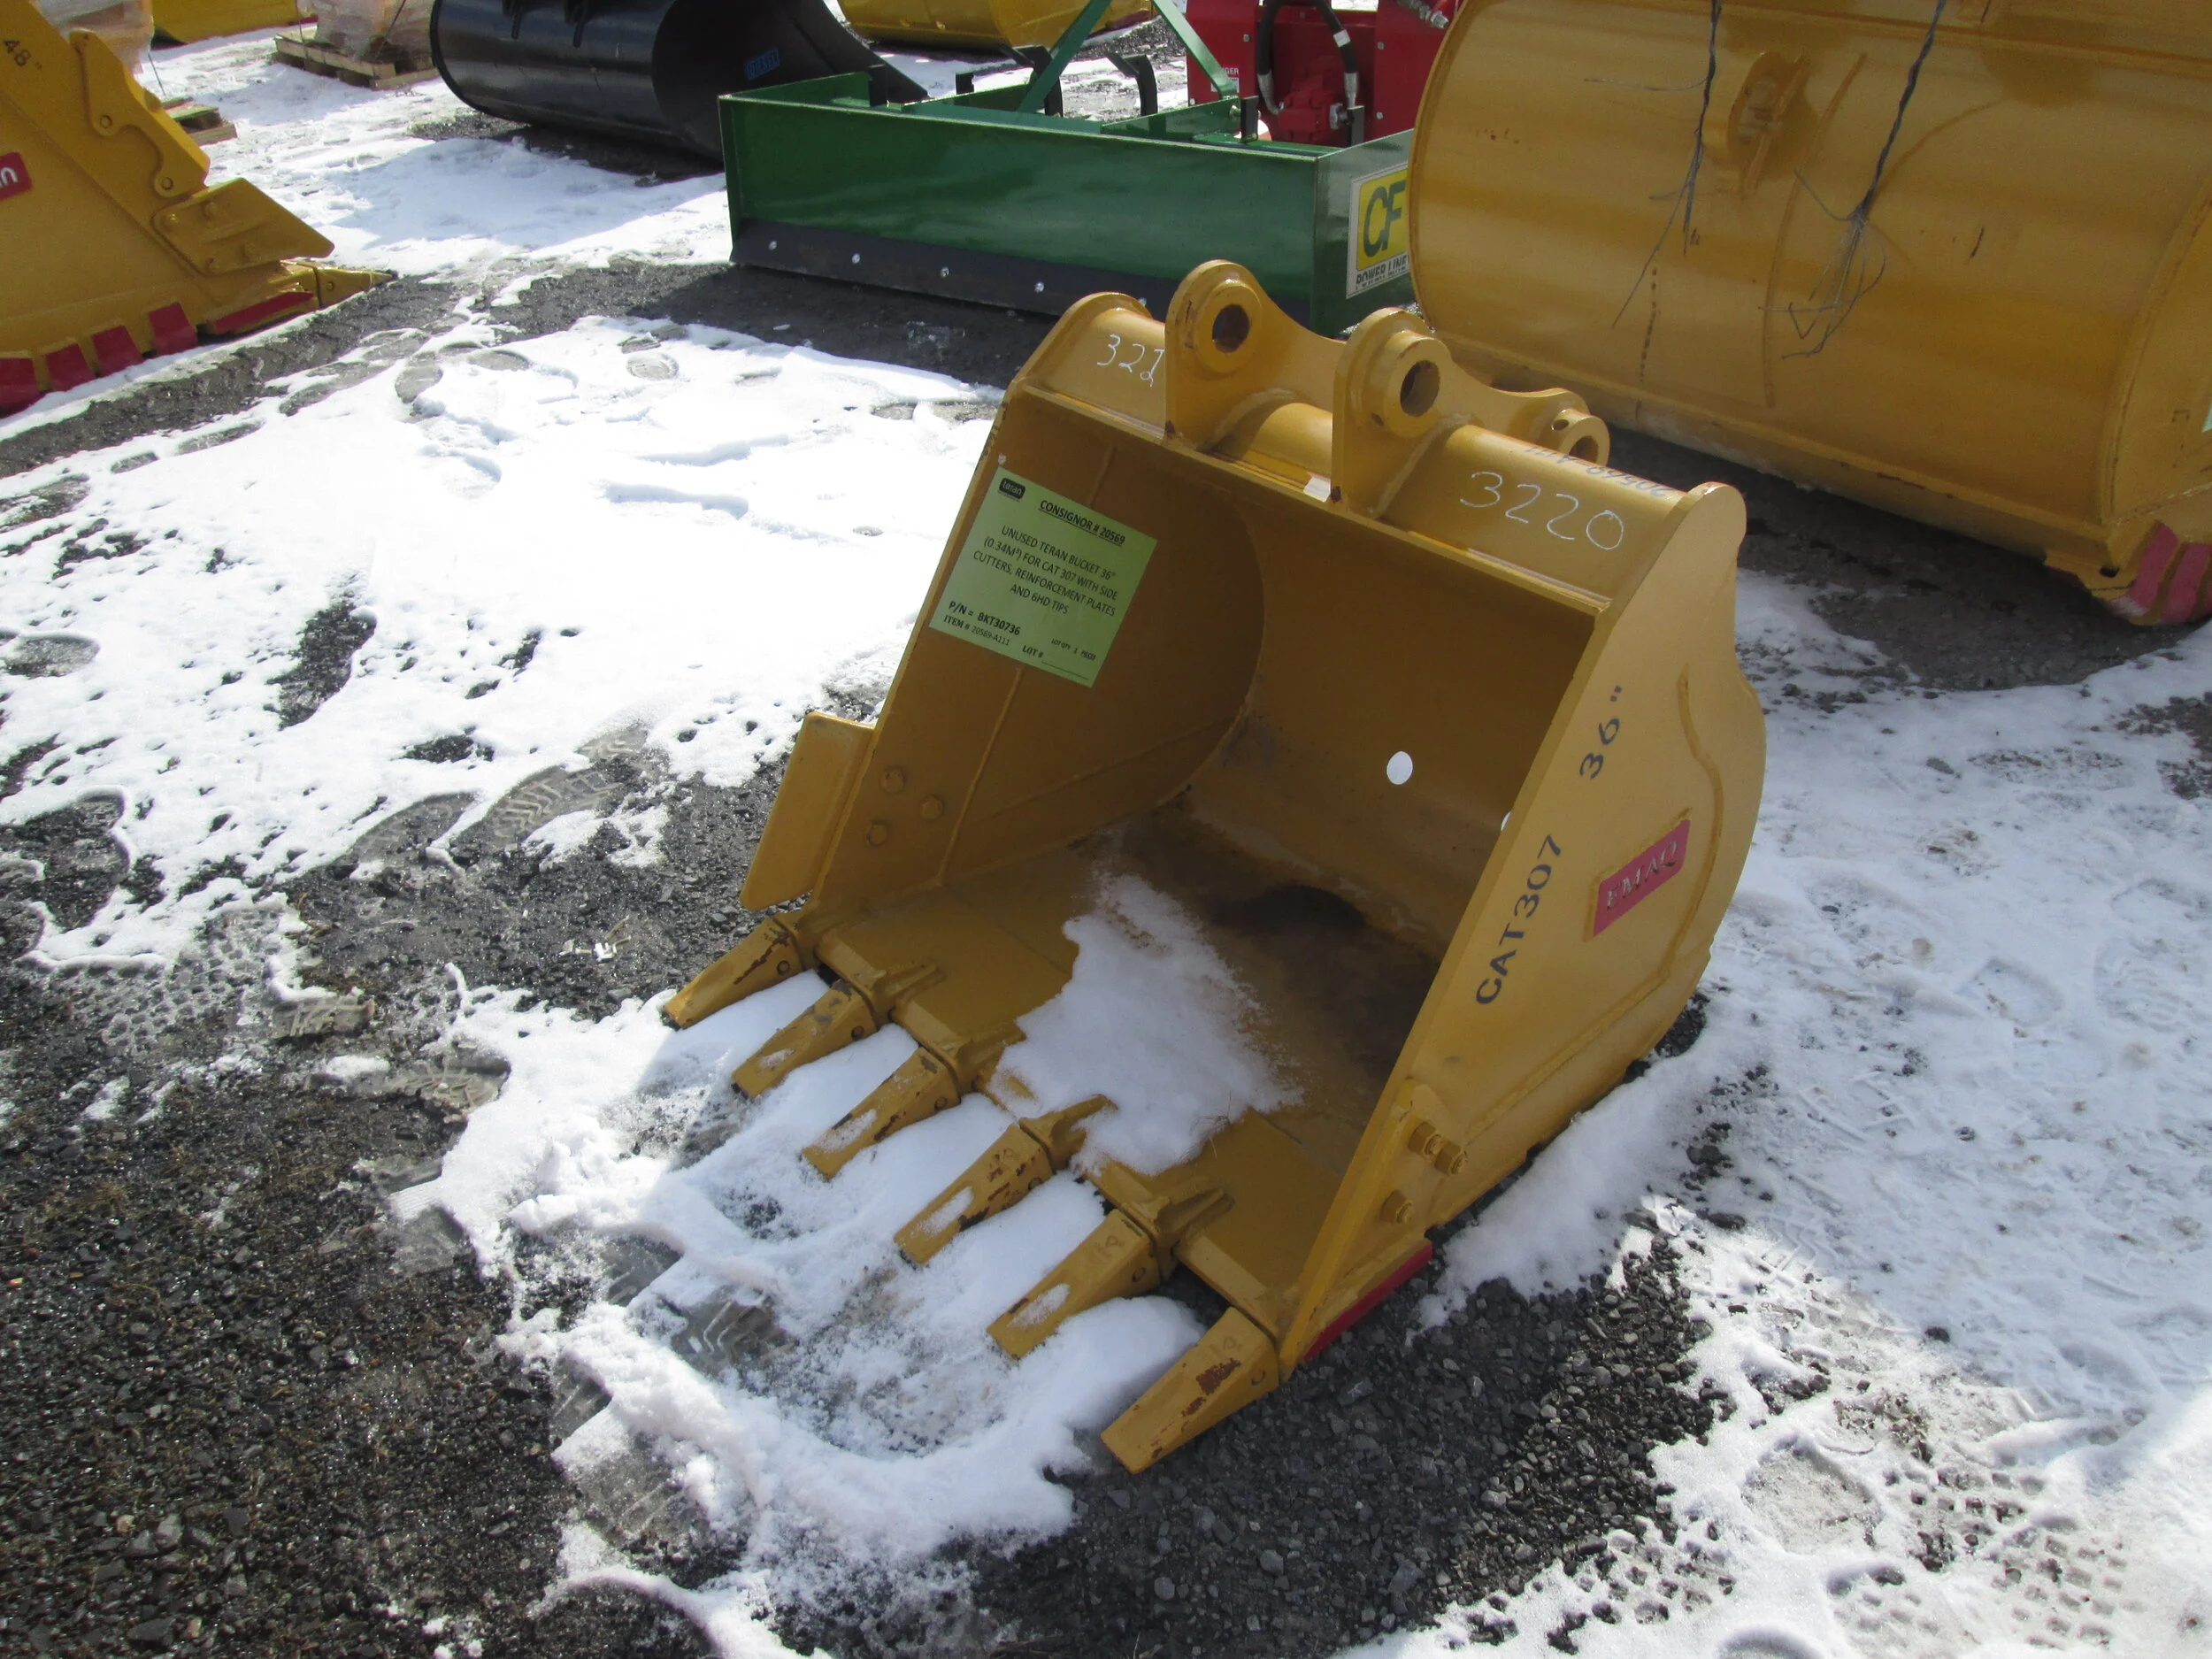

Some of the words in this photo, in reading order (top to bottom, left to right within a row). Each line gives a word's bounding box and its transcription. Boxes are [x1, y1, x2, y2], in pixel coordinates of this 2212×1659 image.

[1002, 480, 1023, 495] teran
[1040, 500, 1093, 531] CONSIGNOR
[1100, 527, 1125, 545] 20569
[1460, 471, 1624, 550] 3220
[1002, 525, 1038, 547] UNUSED
[1040, 541, 1068, 561] TERAN
[1069, 555, 1101, 573] BUCKET
[973, 550, 1012, 574] CUTTERS,
[1015, 567, 1087, 603] REINFORCEMENT
[1087, 597, 1116, 617] PLATES
[1023, 553, 1041, 567] FOR
[1041, 561, 1060, 574] CAT
[1060, 569, 1077, 581] 307
[1077, 576, 1098, 591] WITH
[1099, 585, 1118, 600] SIDE
[949, 601, 967, 615] P/N
[978, 612, 1021, 635] BKT30736
[1010, 584, 1031, 598] AND
[1031, 593, 1050, 606] 6HD
[1052, 600, 1069, 614] TIPS
[944, 615, 964, 628] ITEM
[1022, 645, 1038, 657] LOT
